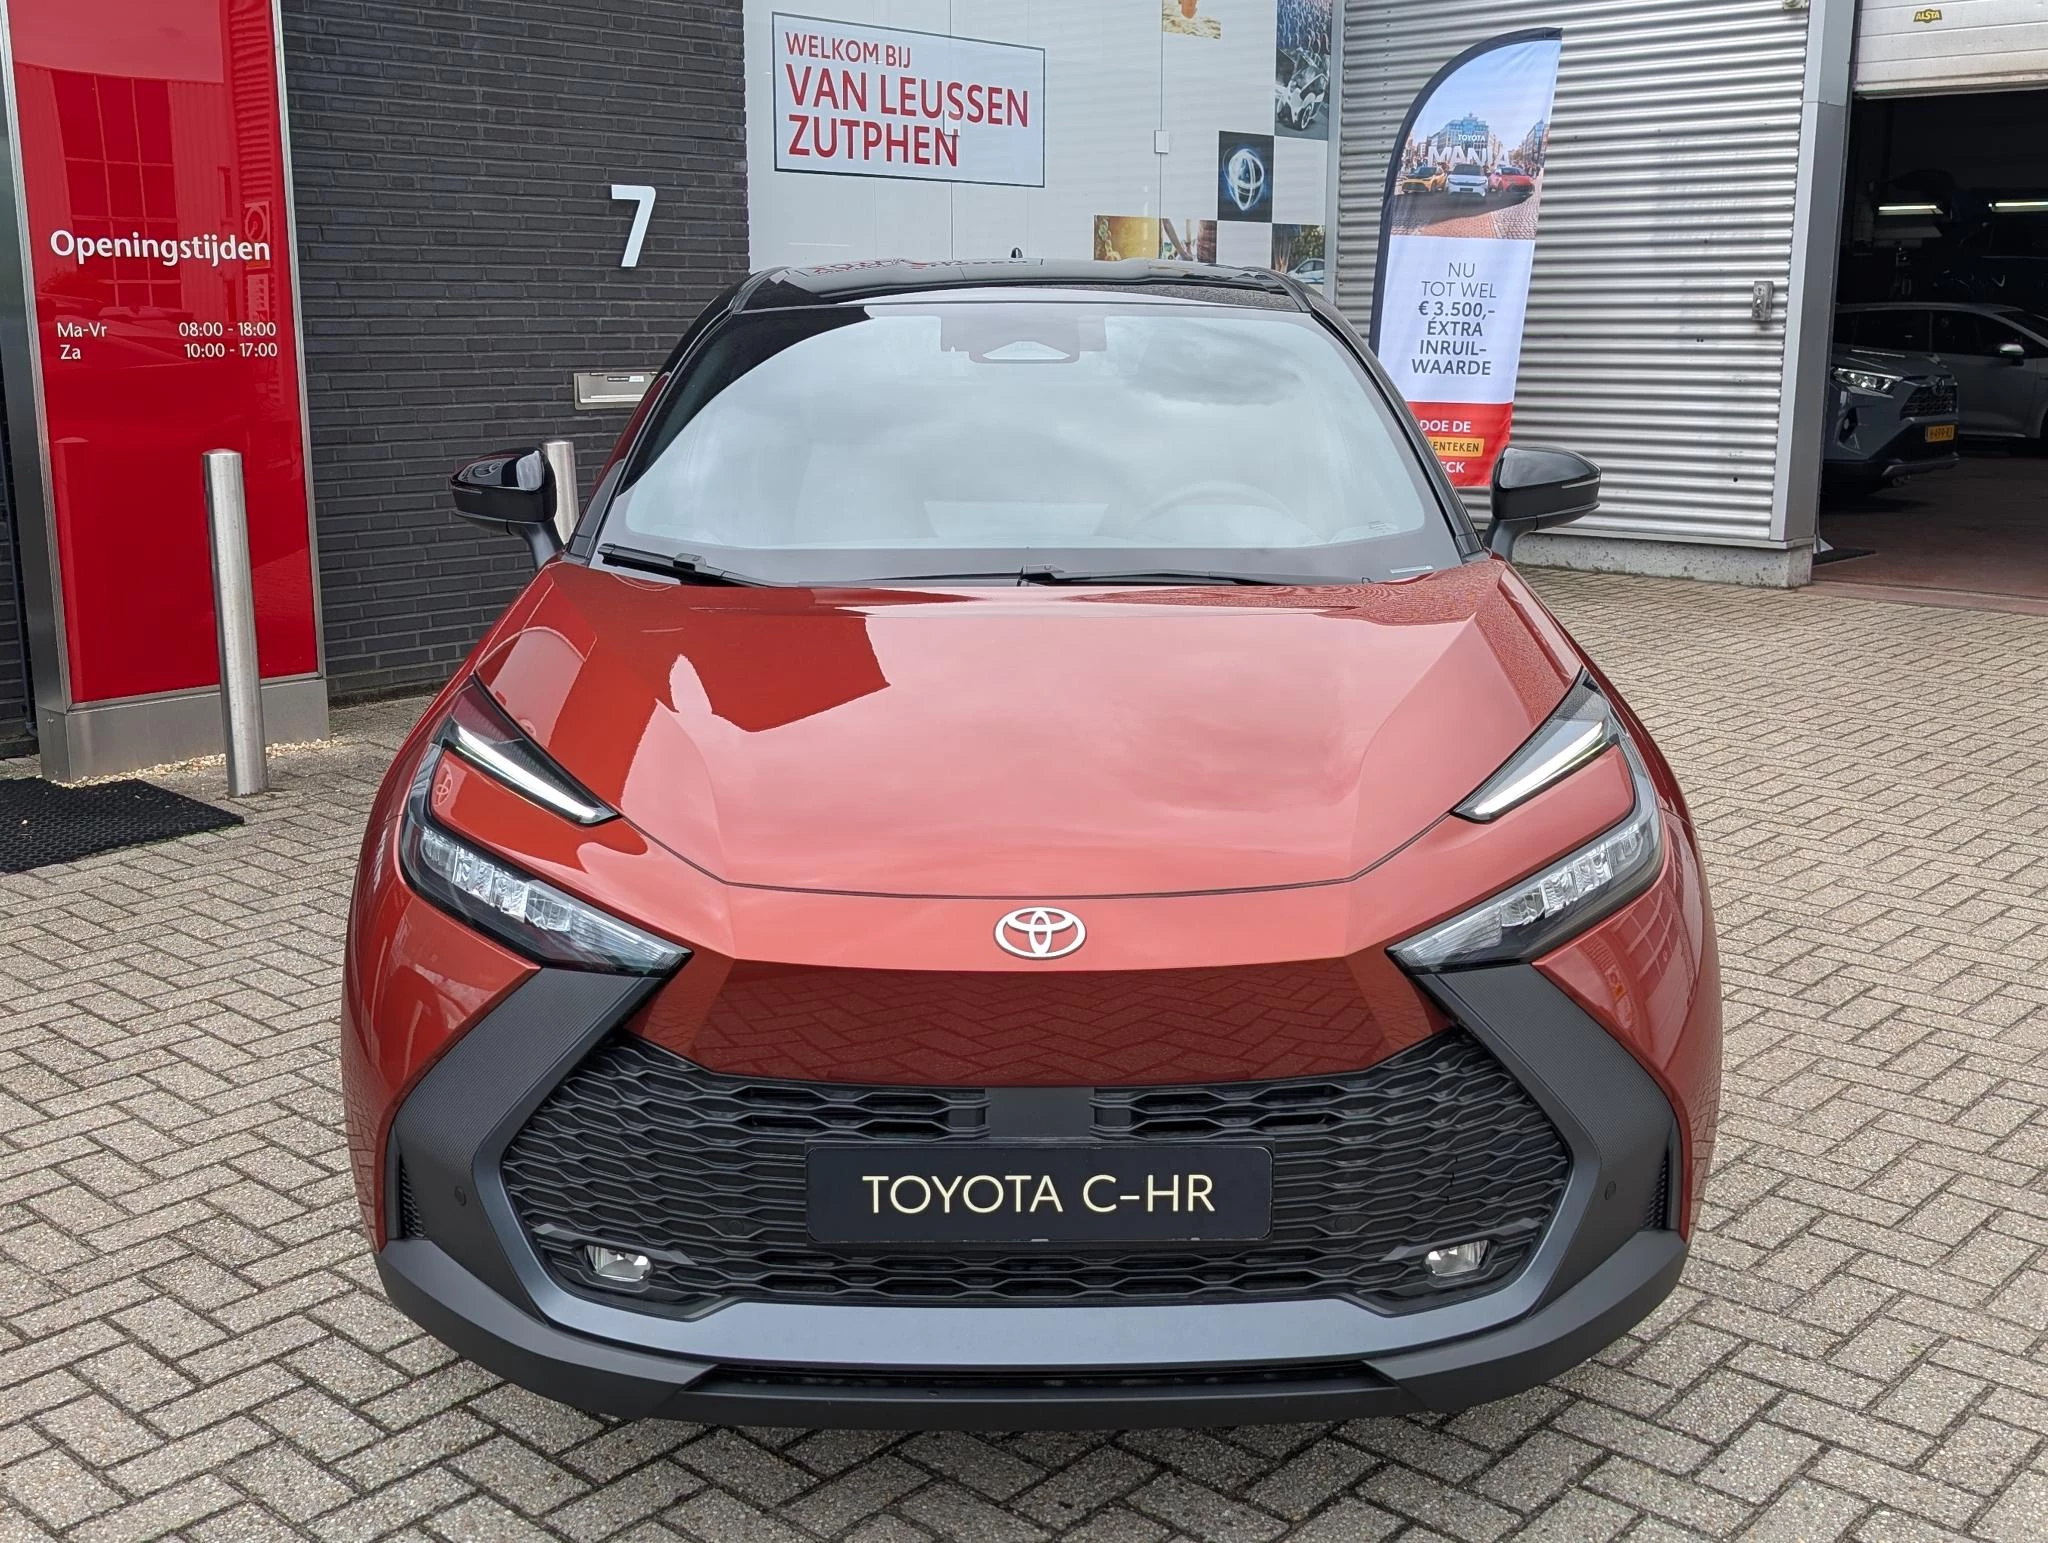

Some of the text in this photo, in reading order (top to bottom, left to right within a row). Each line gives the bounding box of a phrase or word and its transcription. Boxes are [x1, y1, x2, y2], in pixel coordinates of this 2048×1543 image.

[1915, 11, 1940, 20] ALSTA
[785, 32, 911, 68] WELKOM BIJ
[785, 63, 1028, 128] VAN LEUSSEN
[788, 114, 958, 167] ZUTPHEN
[1458, 134, 1486, 142] TOYOTA
[1427, 145, 1510, 168] MANIA
[611, 184, 656, 267] 7
[50, 230, 270, 266] Openingstijden
[1448, 262, 1475, 278] NU
[1421, 281, 1497, 298] TOT WEL
[57, 322, 107, 338] Ma-Vr
[178, 322, 223, 337] 08:00
[238, 322, 277, 337] 18:00
[1427, 316, 1483, 337] ÉXTRA
[60, 344, 81, 360] Za
[184, 342, 225, 358] 10:00
[239, 342, 278, 357] 17:00
[1420, 339, 1487, 356] INRUIL-
[1411, 359, 1492, 375] WAARDE
[1420, 420, 1471, 432] DOE DE
[1431, 441, 1480, 452] ENTEKEN
[862, 1174, 1216, 1214] TOYOTA C-HR
